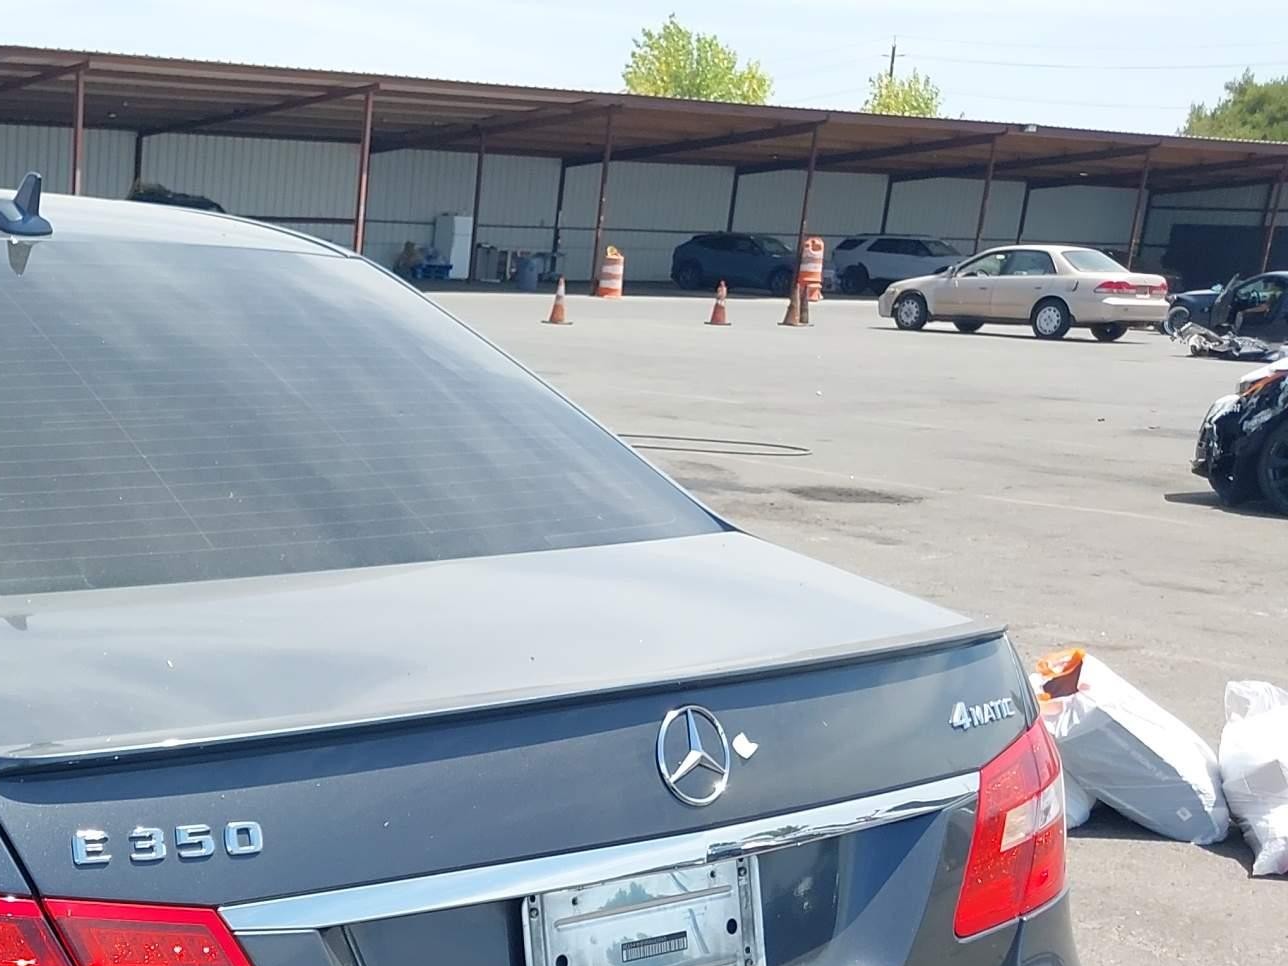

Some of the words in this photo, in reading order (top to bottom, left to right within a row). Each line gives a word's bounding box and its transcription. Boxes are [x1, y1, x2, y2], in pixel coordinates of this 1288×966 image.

[948, 697, 1017, 730] 4MATIC
[71, 828, 113, 865] E
[129, 820, 264, 862] 350
